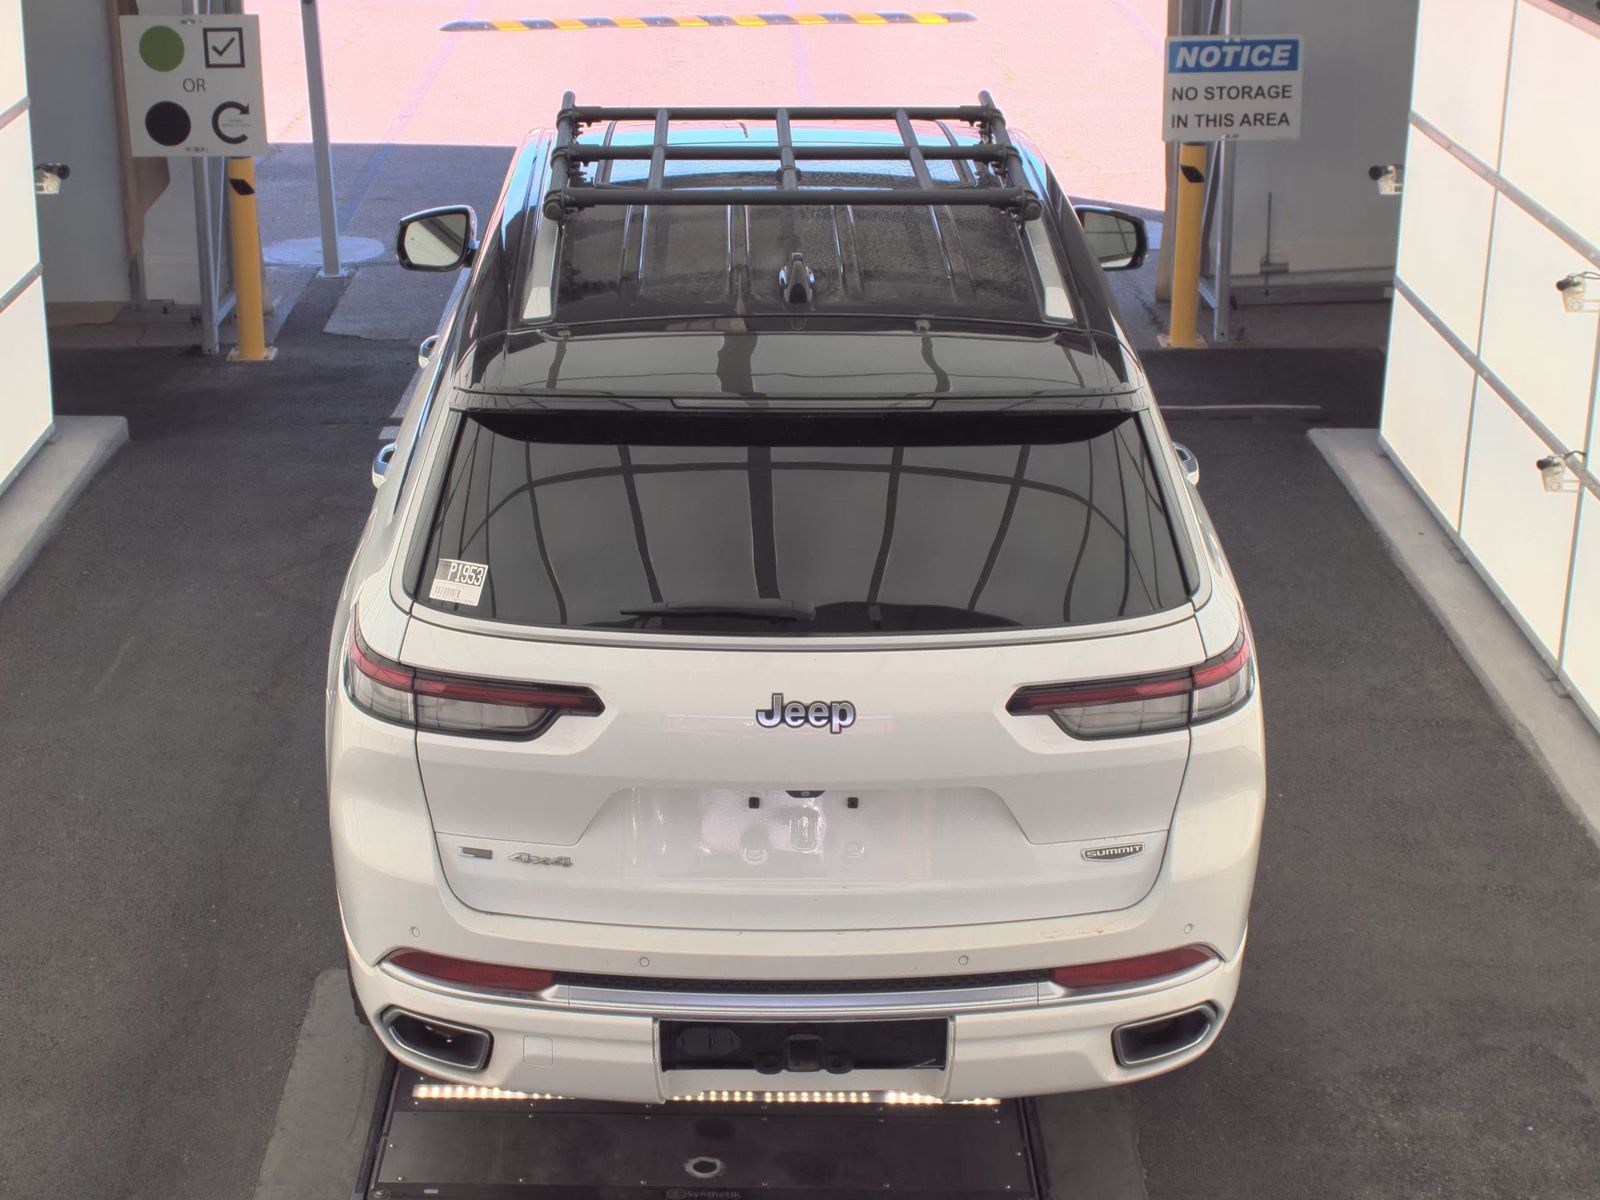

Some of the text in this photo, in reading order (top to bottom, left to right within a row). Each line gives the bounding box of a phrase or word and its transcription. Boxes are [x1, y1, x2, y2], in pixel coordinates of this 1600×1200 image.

[1176, 44, 1292, 68] NOTICE
[182, 78, 206, 92] OR
[1172, 84, 1293, 101] NO STORAGE
[1171, 112, 1291, 128] IN THIS AREA
[447, 562, 484, 586] P1953
[756, 693, 856, 734] Jeep
